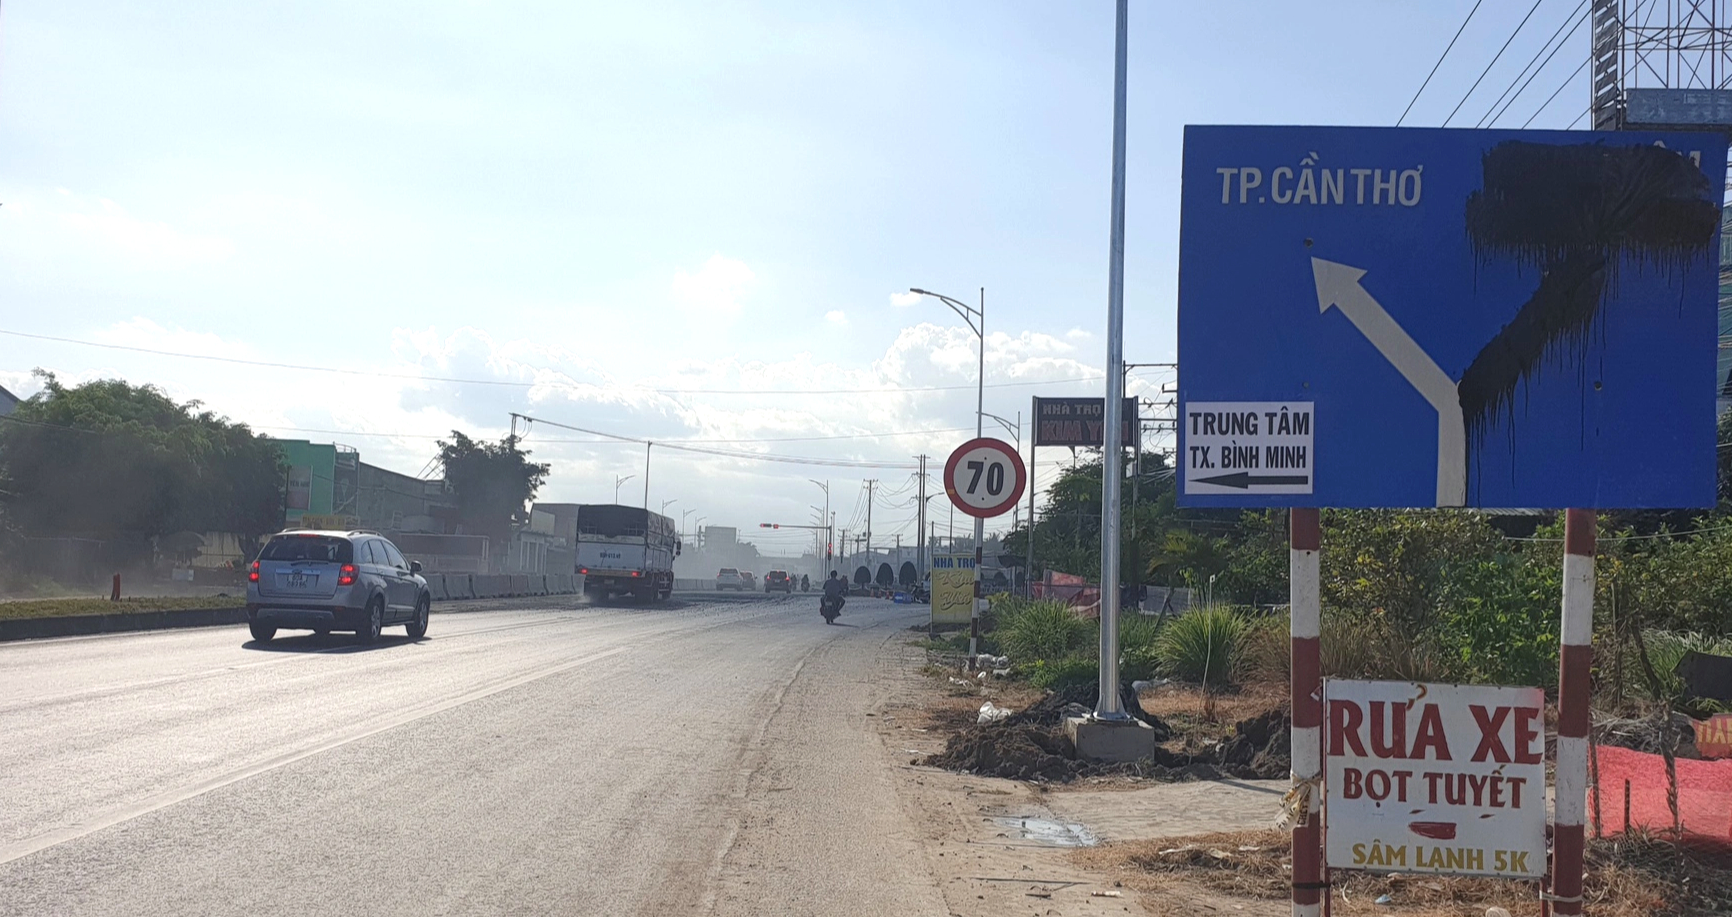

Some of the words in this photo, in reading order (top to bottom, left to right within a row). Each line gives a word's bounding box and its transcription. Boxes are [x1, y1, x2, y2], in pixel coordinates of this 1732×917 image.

[1350, 165, 1424, 207] THƠ
[1042, 401, 1070, 415] NHÀ
[1074, 404, 1101, 417] TRỌ
[1189, 411, 1258, 436] TRUNG
[1265, 405, 1310, 436] TÂM
[1041, 420, 1083, 441] KIM
[1189, 446, 1215, 469] TX.
[1221, 440, 1259, 469] BÌNH
[1265, 446, 1306, 469] MINH
[966, 461, 1004, 496] 70
[1327, 684, 1453, 762] RỬA
[1468, 704, 1544, 765] XE
[1343, 767, 1413, 808] BỌT
[1422, 764, 1527, 809] TUYẾT
[1352, 838, 1407, 867] SÂM
[1493, 849, 1530, 873] 5K
